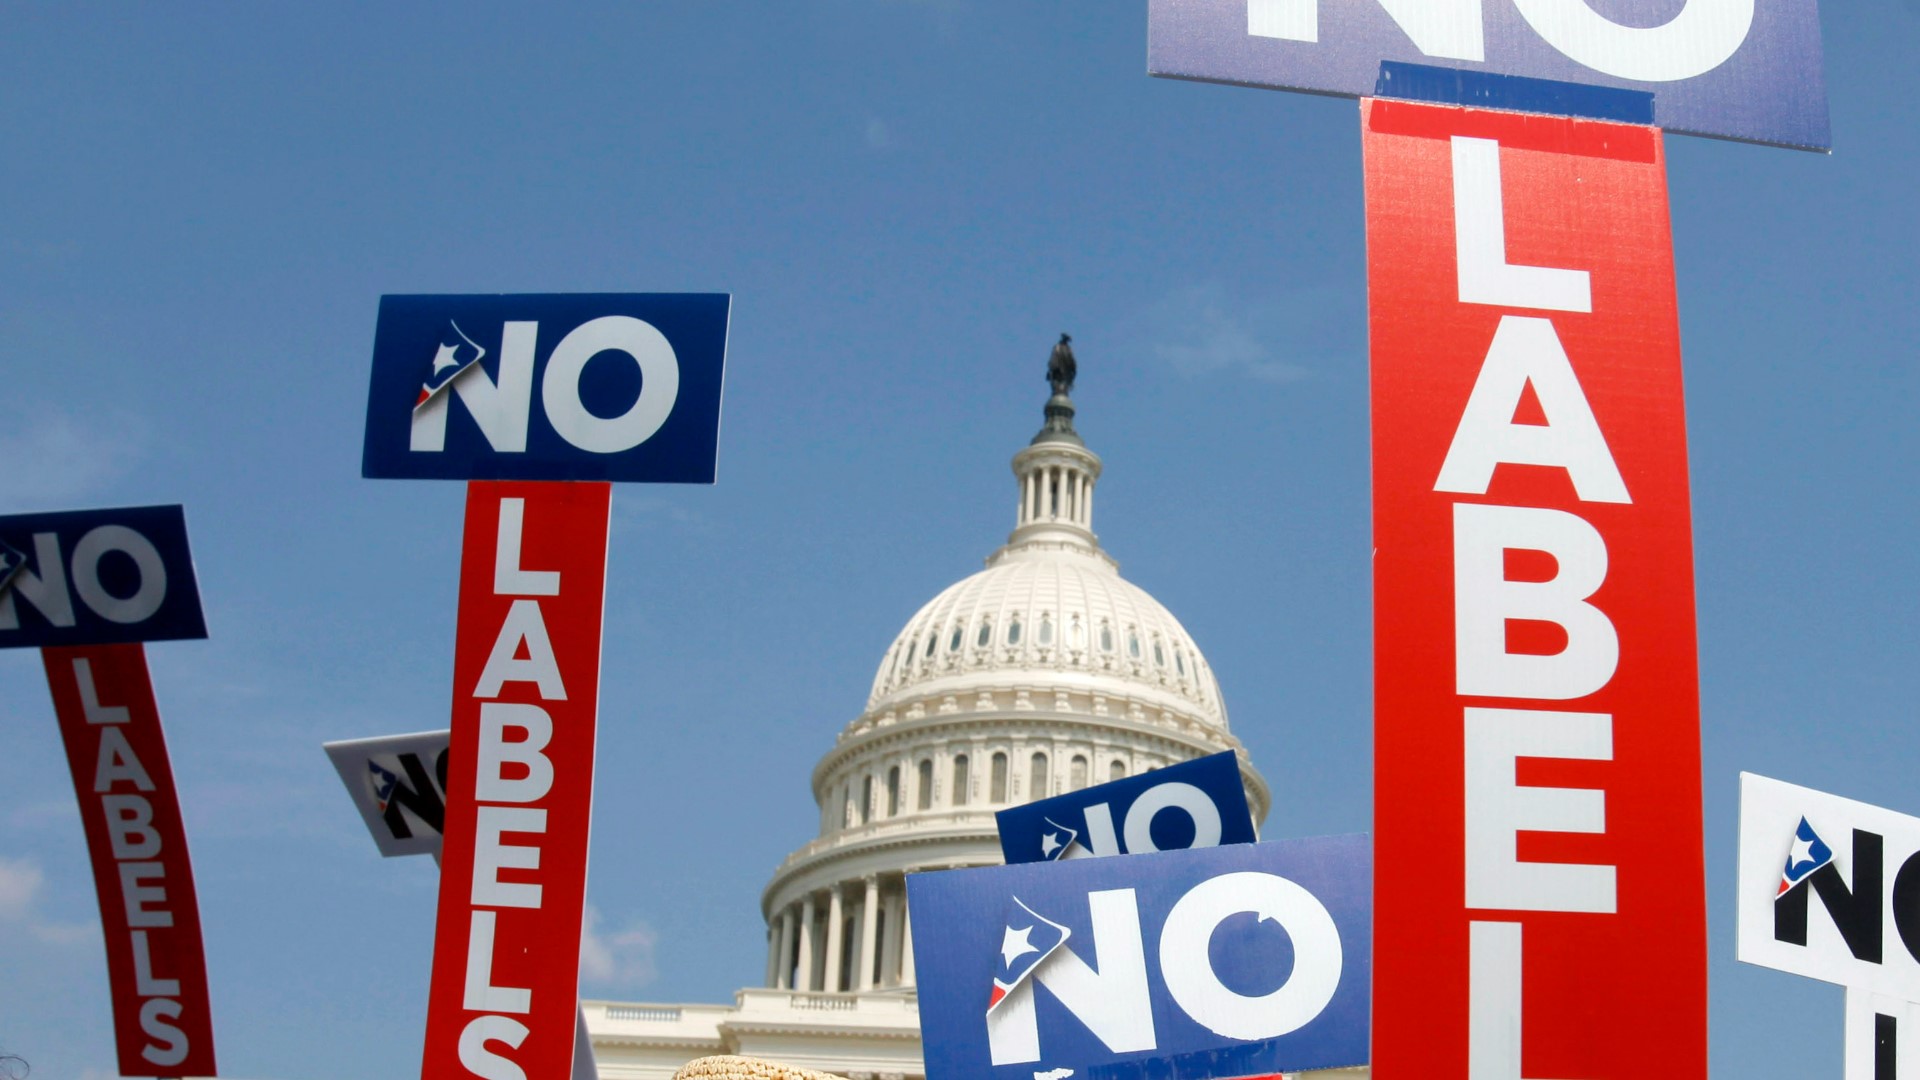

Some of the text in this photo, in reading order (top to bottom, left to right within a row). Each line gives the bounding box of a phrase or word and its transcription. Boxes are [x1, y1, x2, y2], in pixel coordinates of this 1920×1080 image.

[409, 315, 680, 453] NO
[0, 524, 167, 630] NO
[1433, 135, 1632, 1080] LABEL
[72, 658, 190, 1066] LABELS
[383, 745, 450, 839] N
[457, 497, 568, 1080] LABELS
[986, 871, 1343, 1066] NO
[1774, 827, 1920, 965] N
